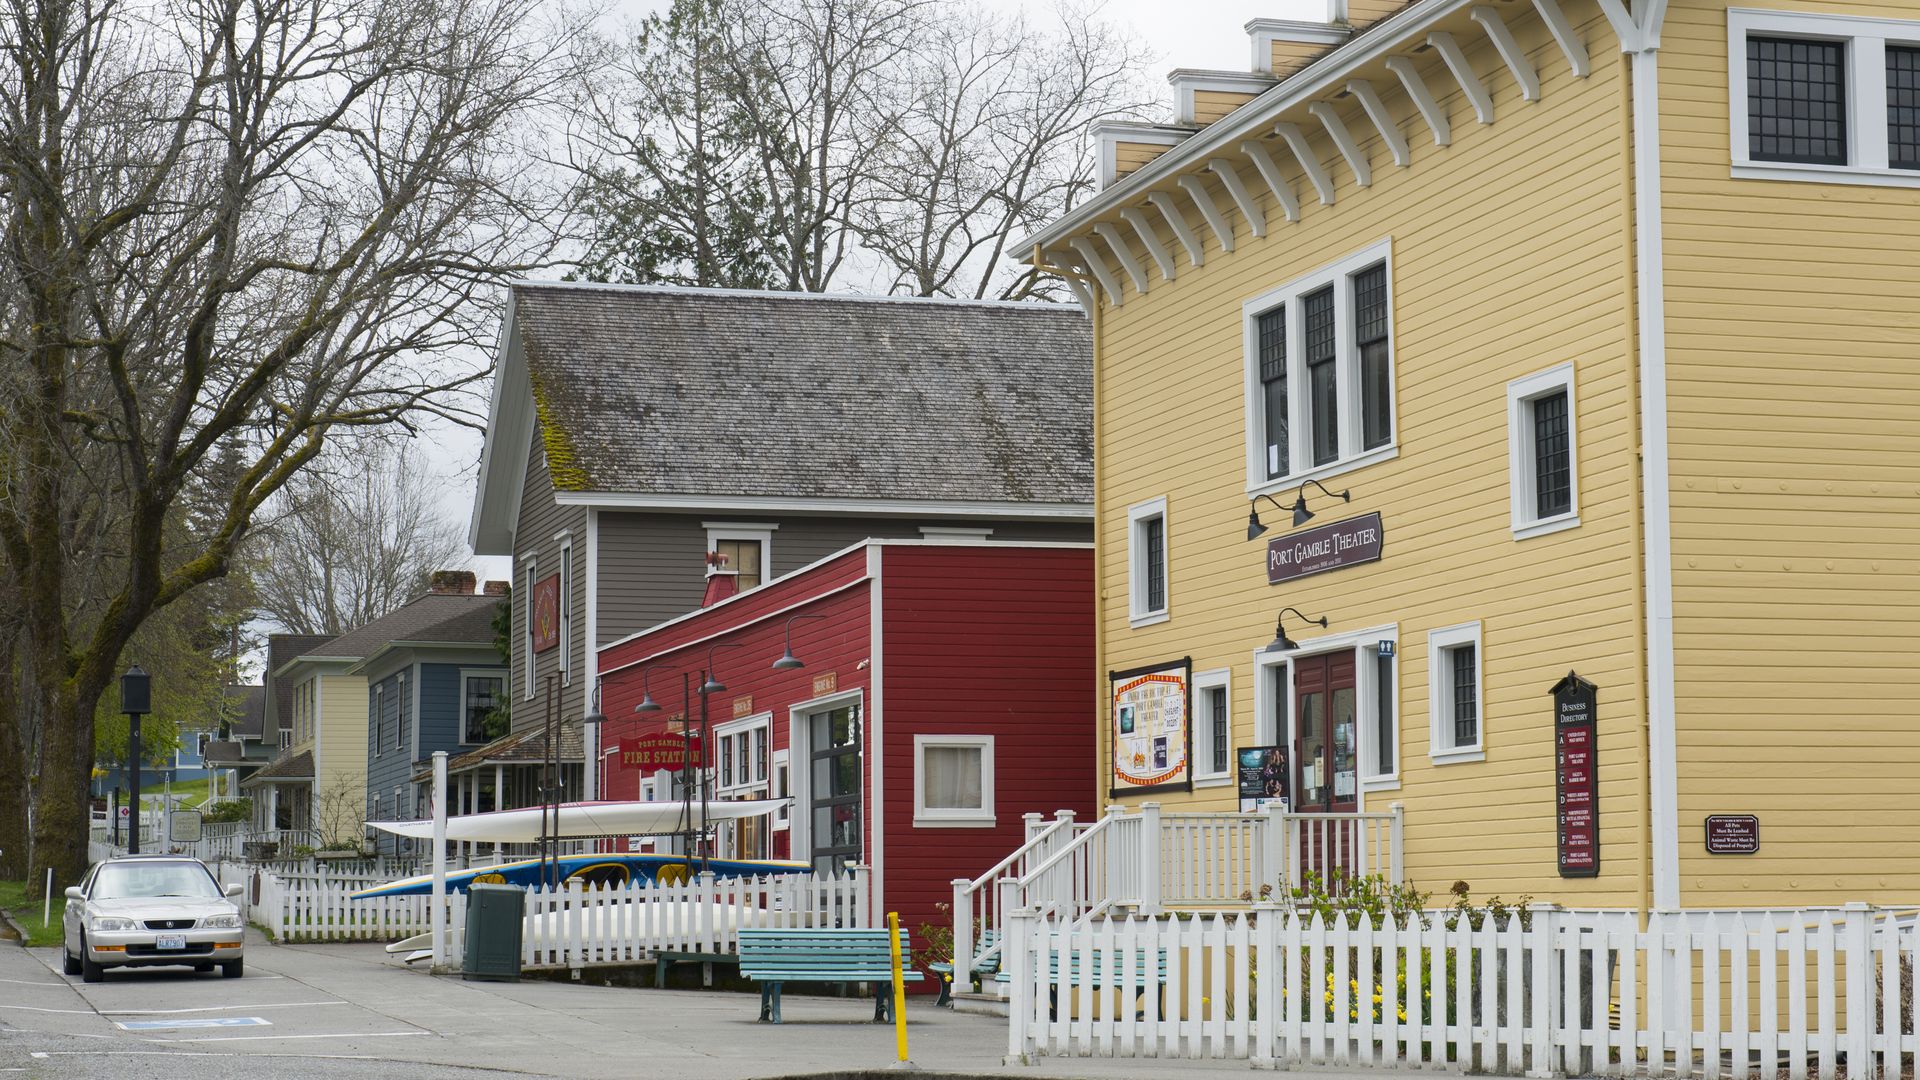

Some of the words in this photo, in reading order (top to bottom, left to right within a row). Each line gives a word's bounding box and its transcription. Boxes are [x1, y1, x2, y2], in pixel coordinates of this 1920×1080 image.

[1270, 548, 1293, 570] PORT
[1295, 538, 1331, 564] GAMBLE
[1332, 528, 1377, 555] THEATER
[814, 680, 826, 693] ENGINE
[831, 676, 835, 689] 9
[1562, 702, 1586, 712] BUSINESS
[1560, 714, 1588, 722] DIRECTORY
[638, 740, 656, 748] PORT
[657, 739, 685, 748] GAMBLE
[624, 751, 650, 764] FIRE
[654, 750, 700, 763] STATIN
